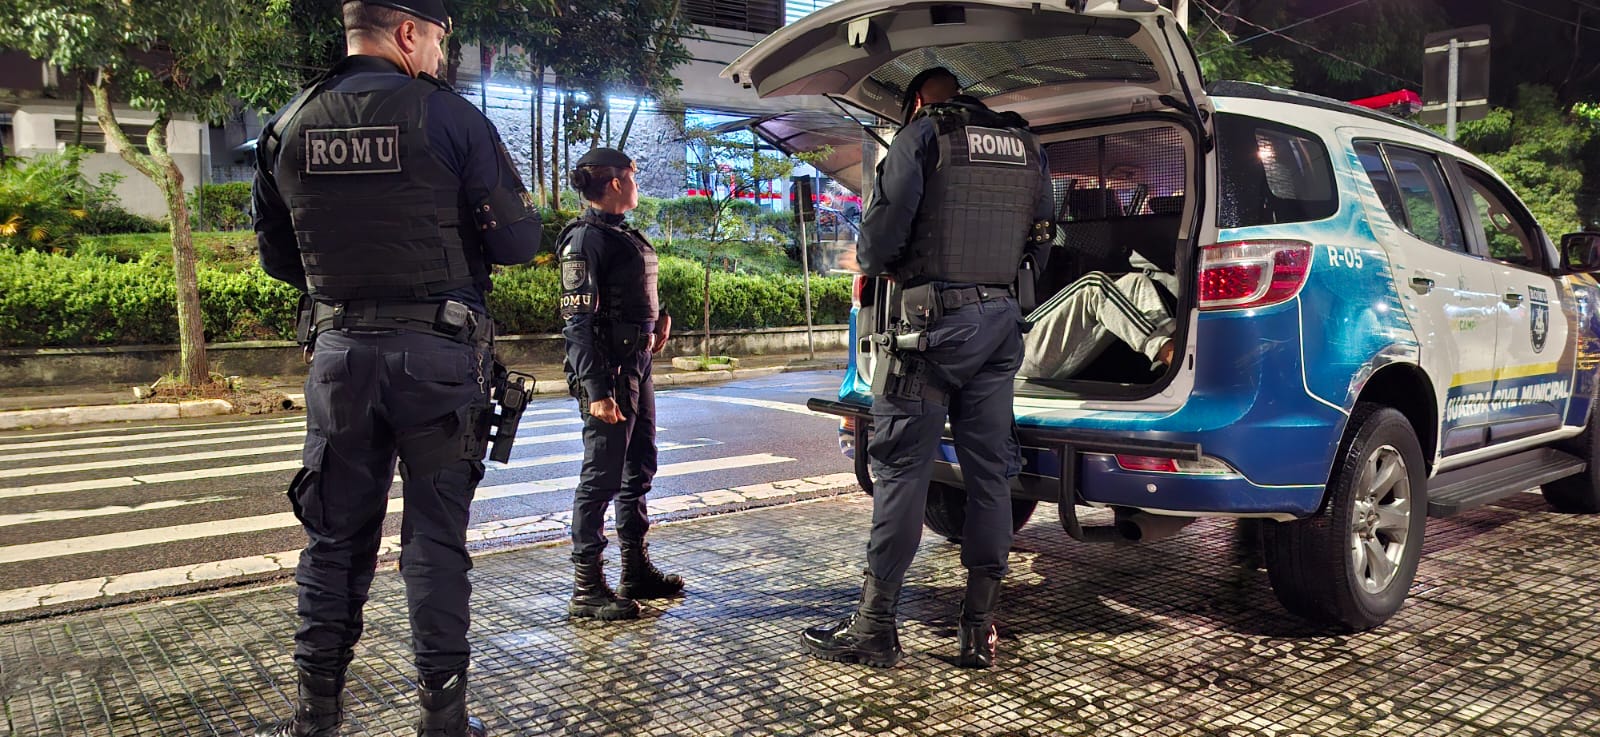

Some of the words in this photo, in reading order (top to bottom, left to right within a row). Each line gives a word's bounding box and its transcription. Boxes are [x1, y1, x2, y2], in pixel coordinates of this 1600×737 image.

[311, 137, 394, 165] ROMU
[968, 133, 1024, 157] ROMU
[1327, 245, 1364, 269] R-05
[1447, 392, 1490, 421] GUARDA
[1491, 389, 1518, 410] CIVIL
[1520, 380, 1568, 405] MUNICIPAL
